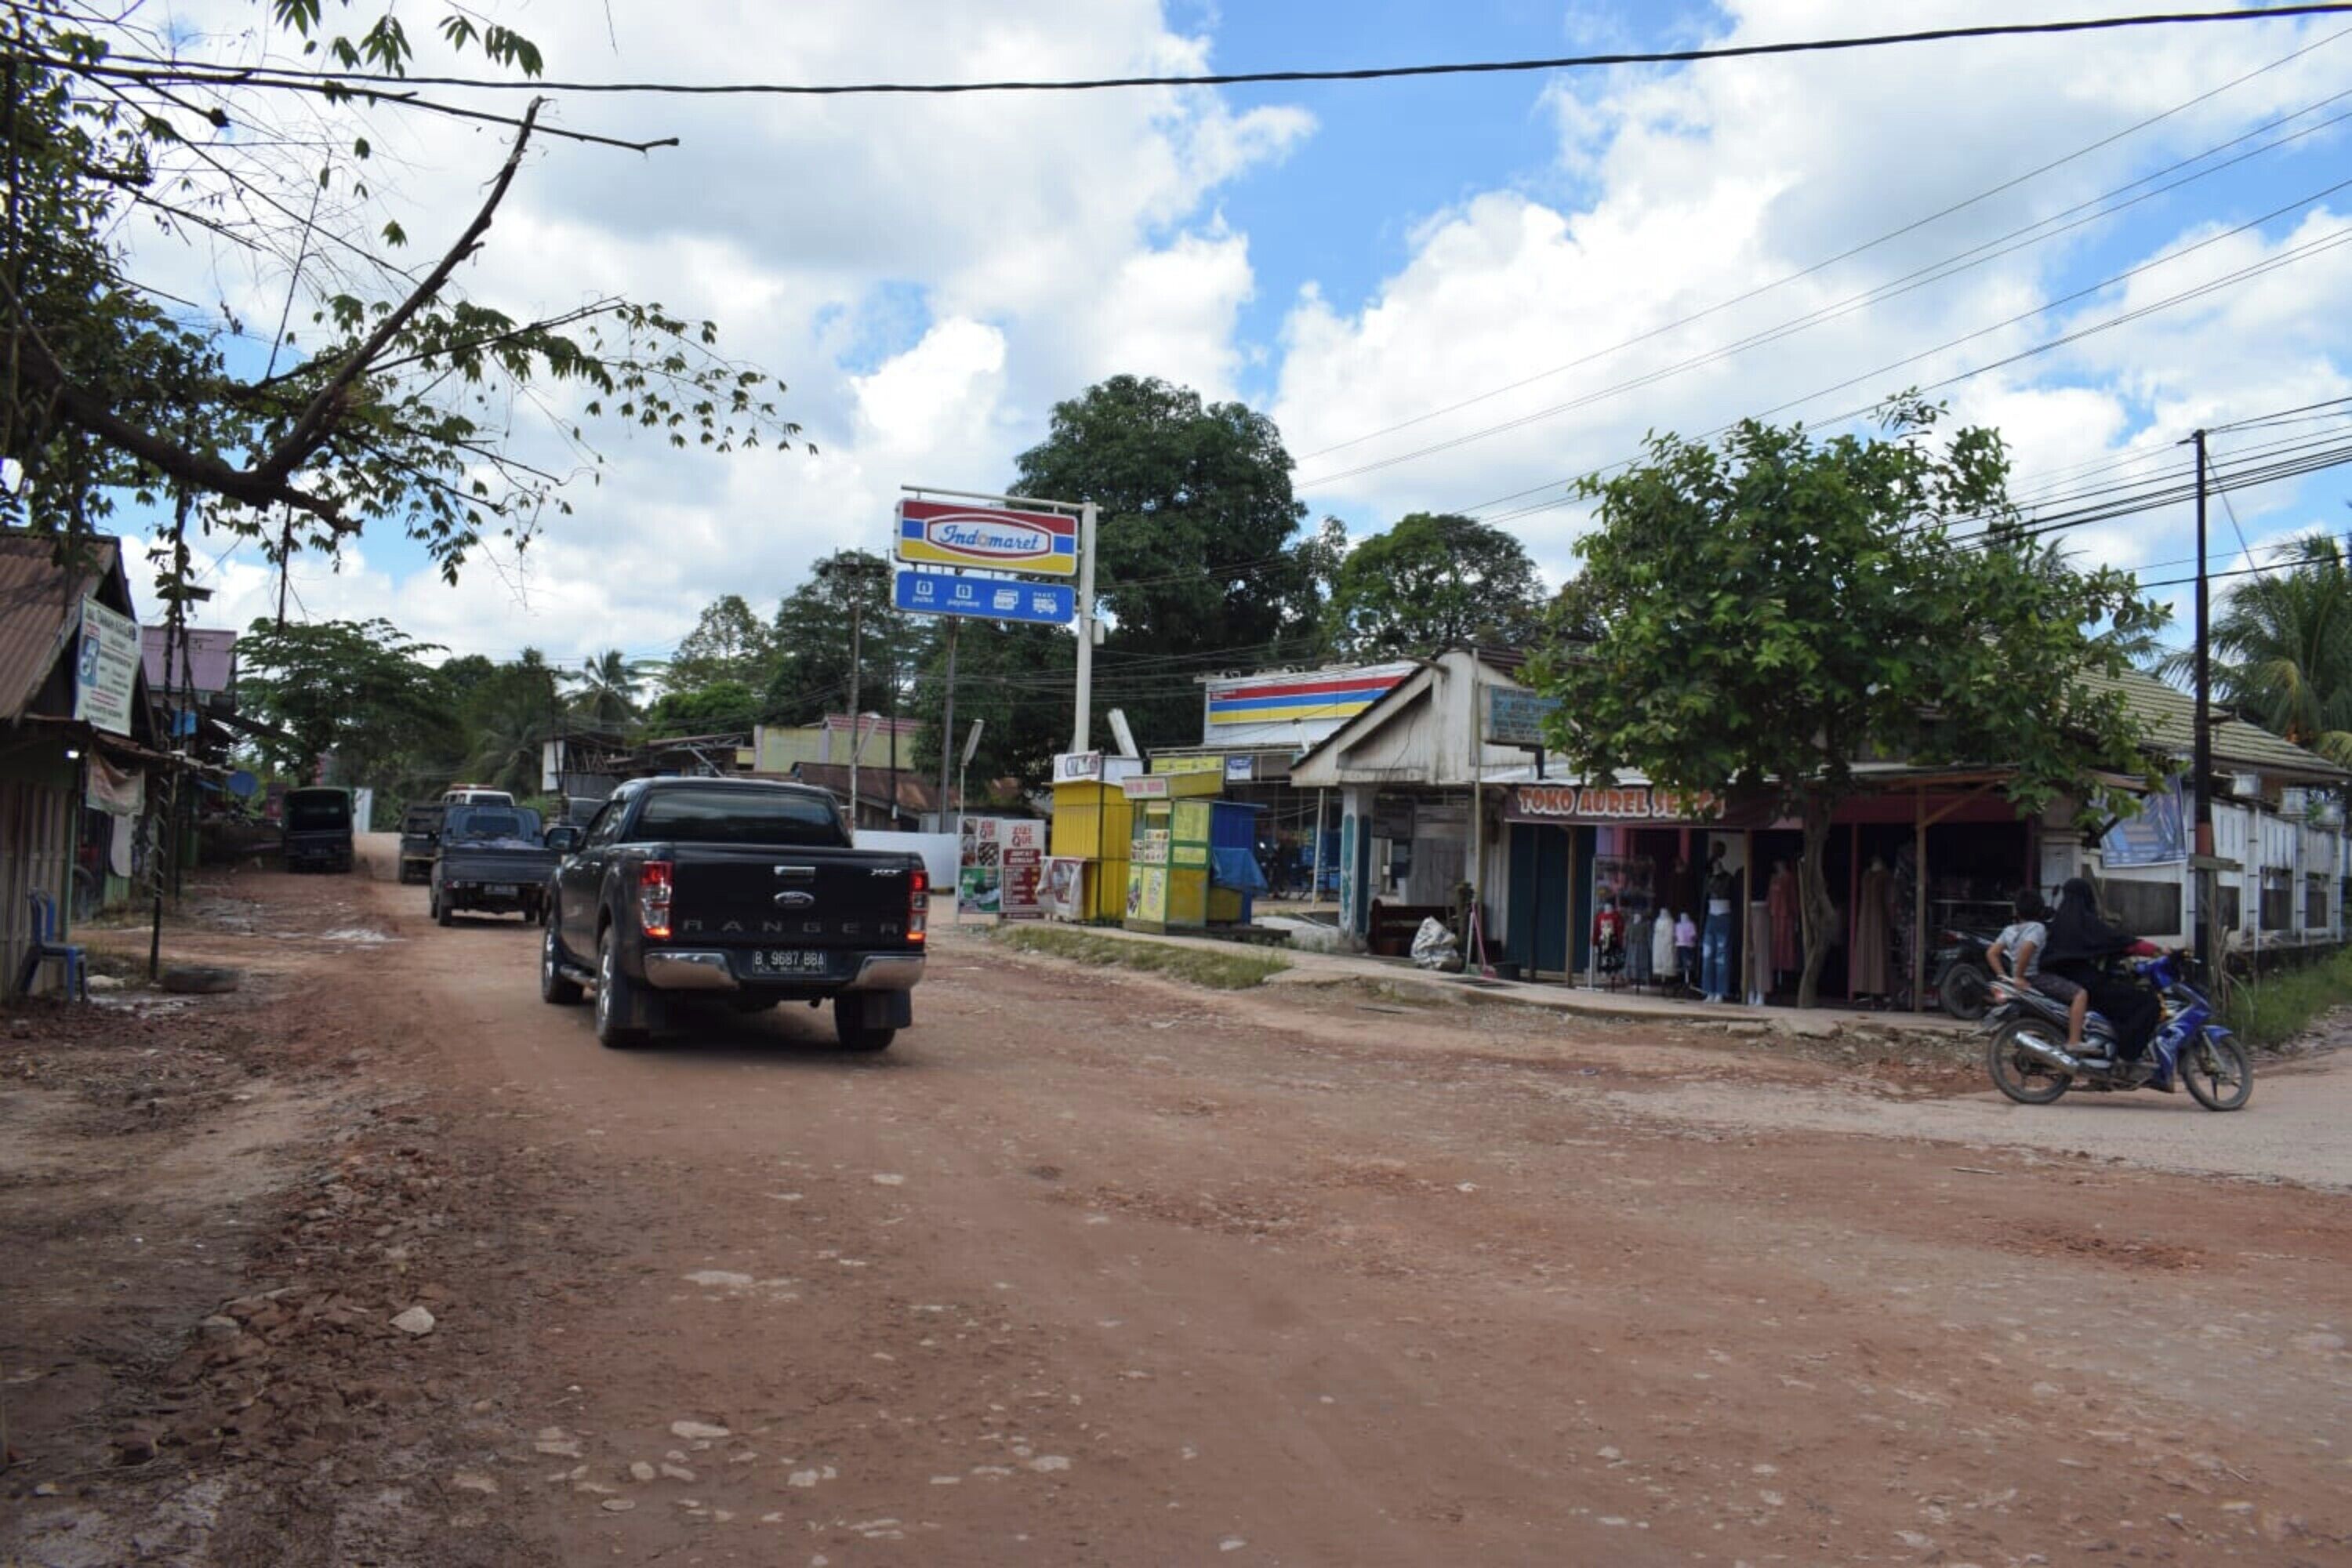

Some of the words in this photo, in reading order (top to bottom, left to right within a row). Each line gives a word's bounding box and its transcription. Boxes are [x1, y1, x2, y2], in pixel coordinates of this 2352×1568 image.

[939, 524, 1039, 549] Indomaret
[1518, 786, 1575, 815] TOKO
[1576, 789, 1650, 817] AUREL
[683, 919, 898, 935] RANGER
[755, 951, 763, 965] B
